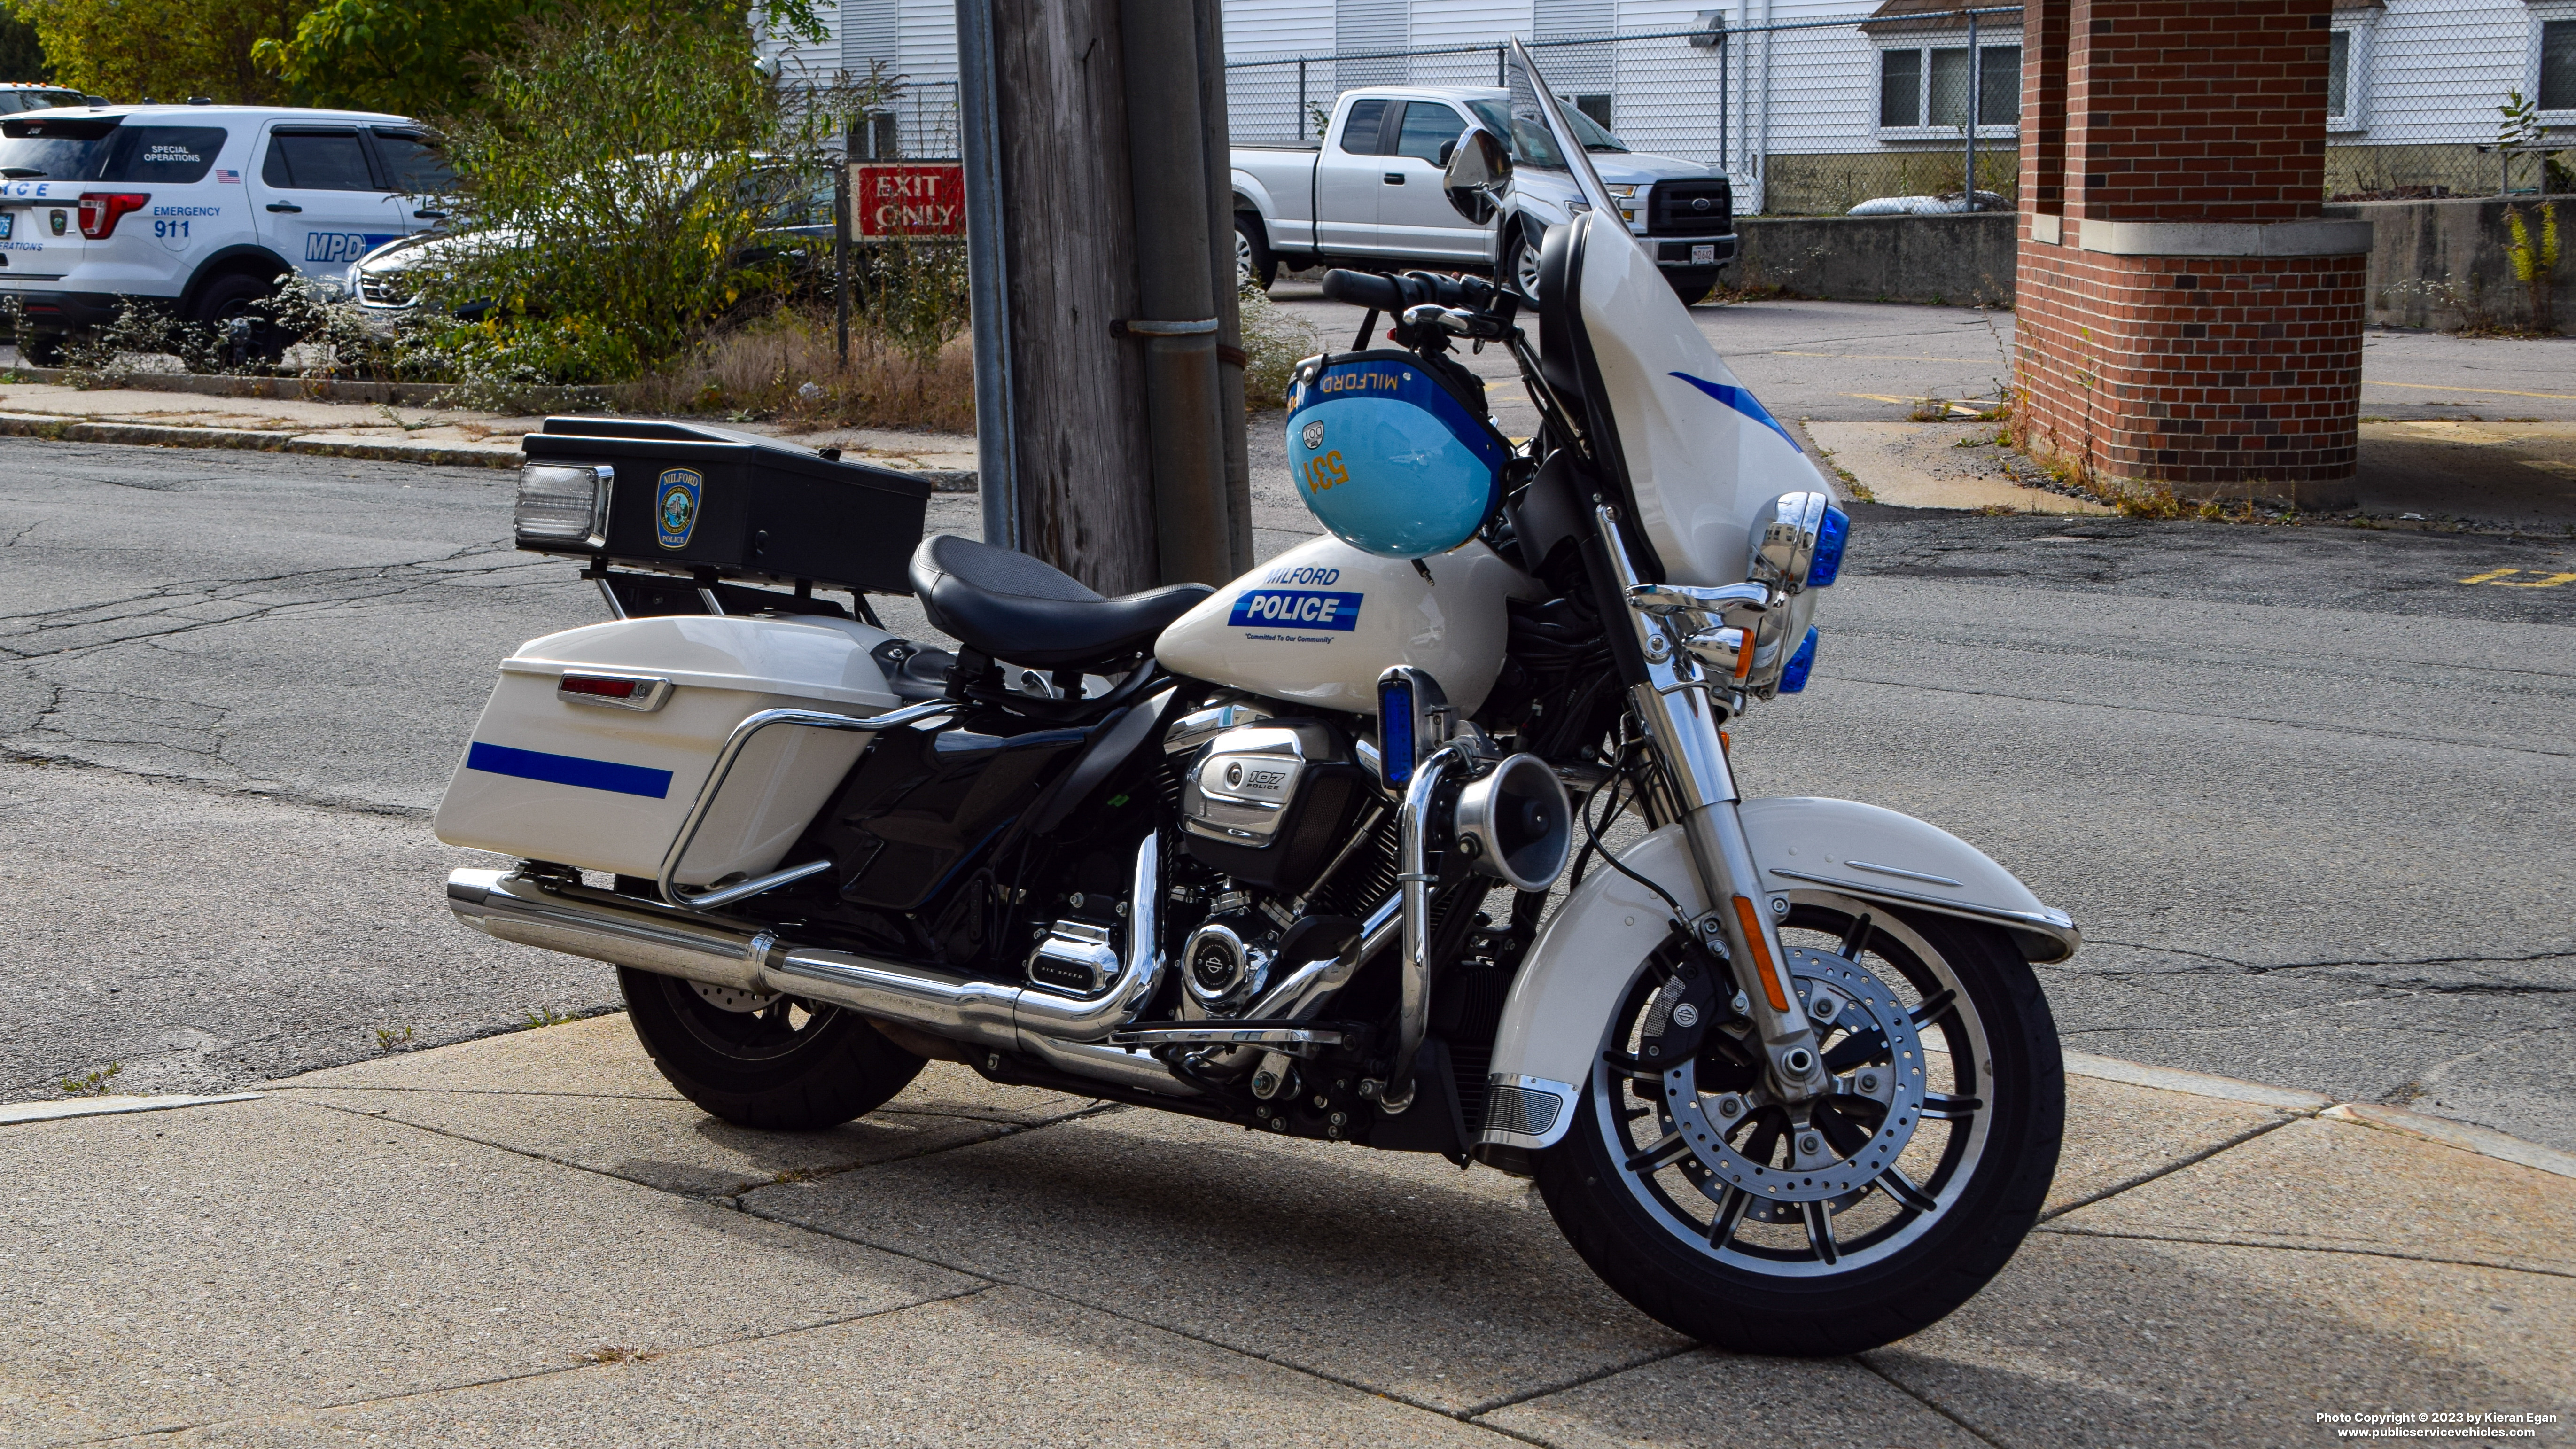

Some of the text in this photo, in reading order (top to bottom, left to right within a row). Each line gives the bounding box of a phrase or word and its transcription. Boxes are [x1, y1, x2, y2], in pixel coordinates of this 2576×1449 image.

[144, 153, 200, 162] OPERATIONS
[877, 175, 942, 197] EXIT
[154, 206, 221, 216] EMERGENCY
[876, 205, 956, 227] ONLY
[154, 220, 190, 238] 911
[305, 232, 366, 262] MPD
[1322, 373, 1398, 393] MILFORD
[1305, 426, 1322, 442] DOT
[663, 472, 698, 487] MILFORD
[1303, 450, 1350, 494] 531
[662, 535, 685, 544] POLICE
[1263, 567, 1340, 586] MILFORD
[1247, 595, 1340, 622] POLICE
[1248, 770, 1286, 785] 107
[1058, 970, 1083, 979] SPEED
